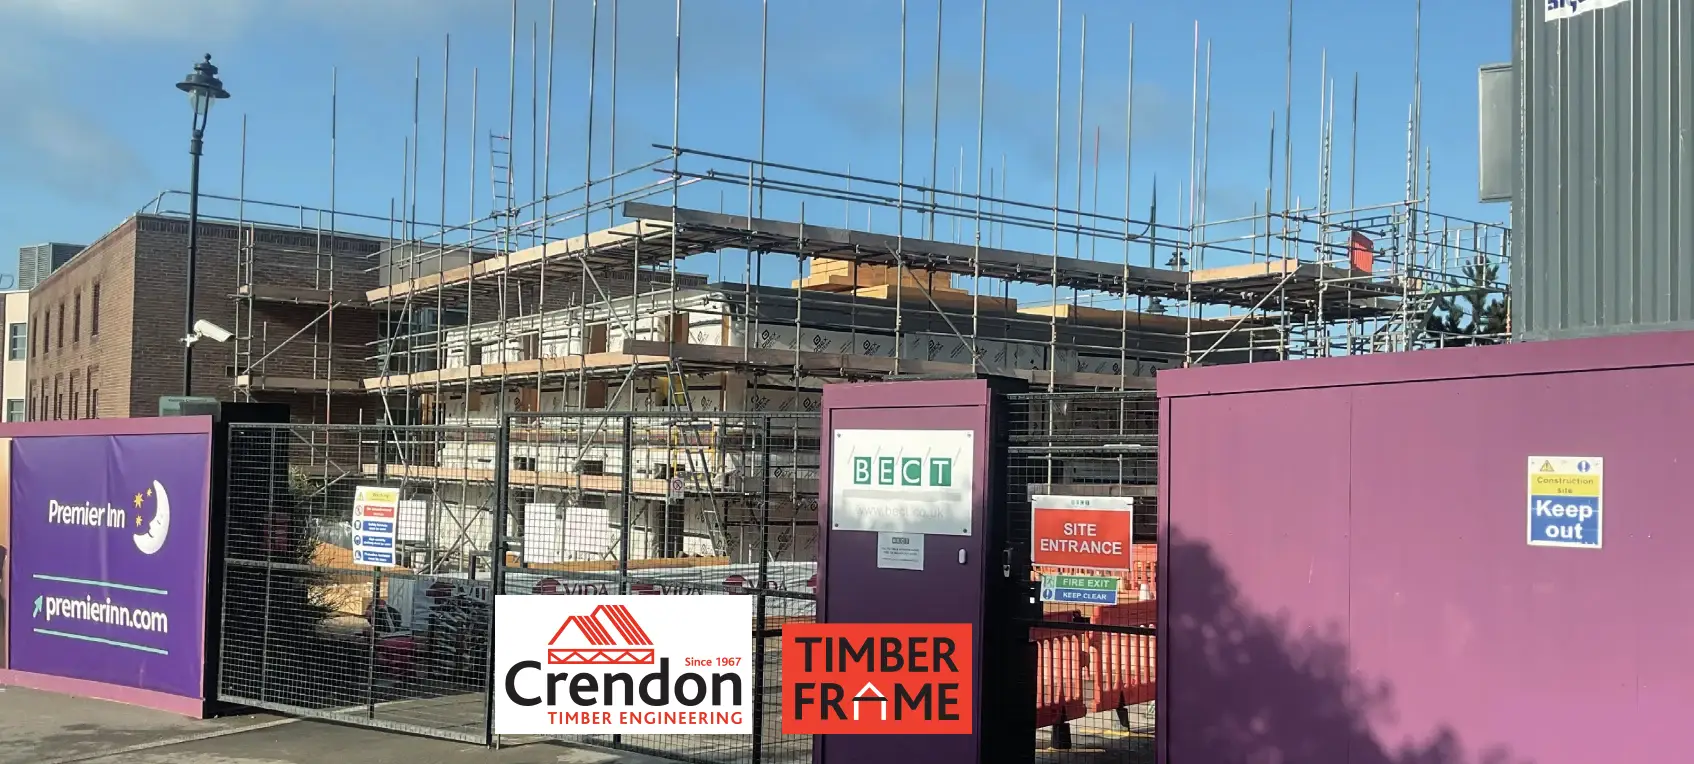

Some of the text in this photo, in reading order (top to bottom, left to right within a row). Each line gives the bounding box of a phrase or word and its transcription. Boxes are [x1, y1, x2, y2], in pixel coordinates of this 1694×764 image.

[855, 458, 950, 485] BECT
[1536, 476, 1594, 485] Construction
[48, 499, 126, 529] Premier Inn
[1536, 499, 1593, 521] Keep
[1063, 523, 1097, 537] SITE
[1545, 523, 1584, 540] out
[1040, 538, 1122, 555] ENTRANCE
[1062, 578, 1110, 588] FIRE EXIT
[46, 594, 168, 633] premierinn.com
